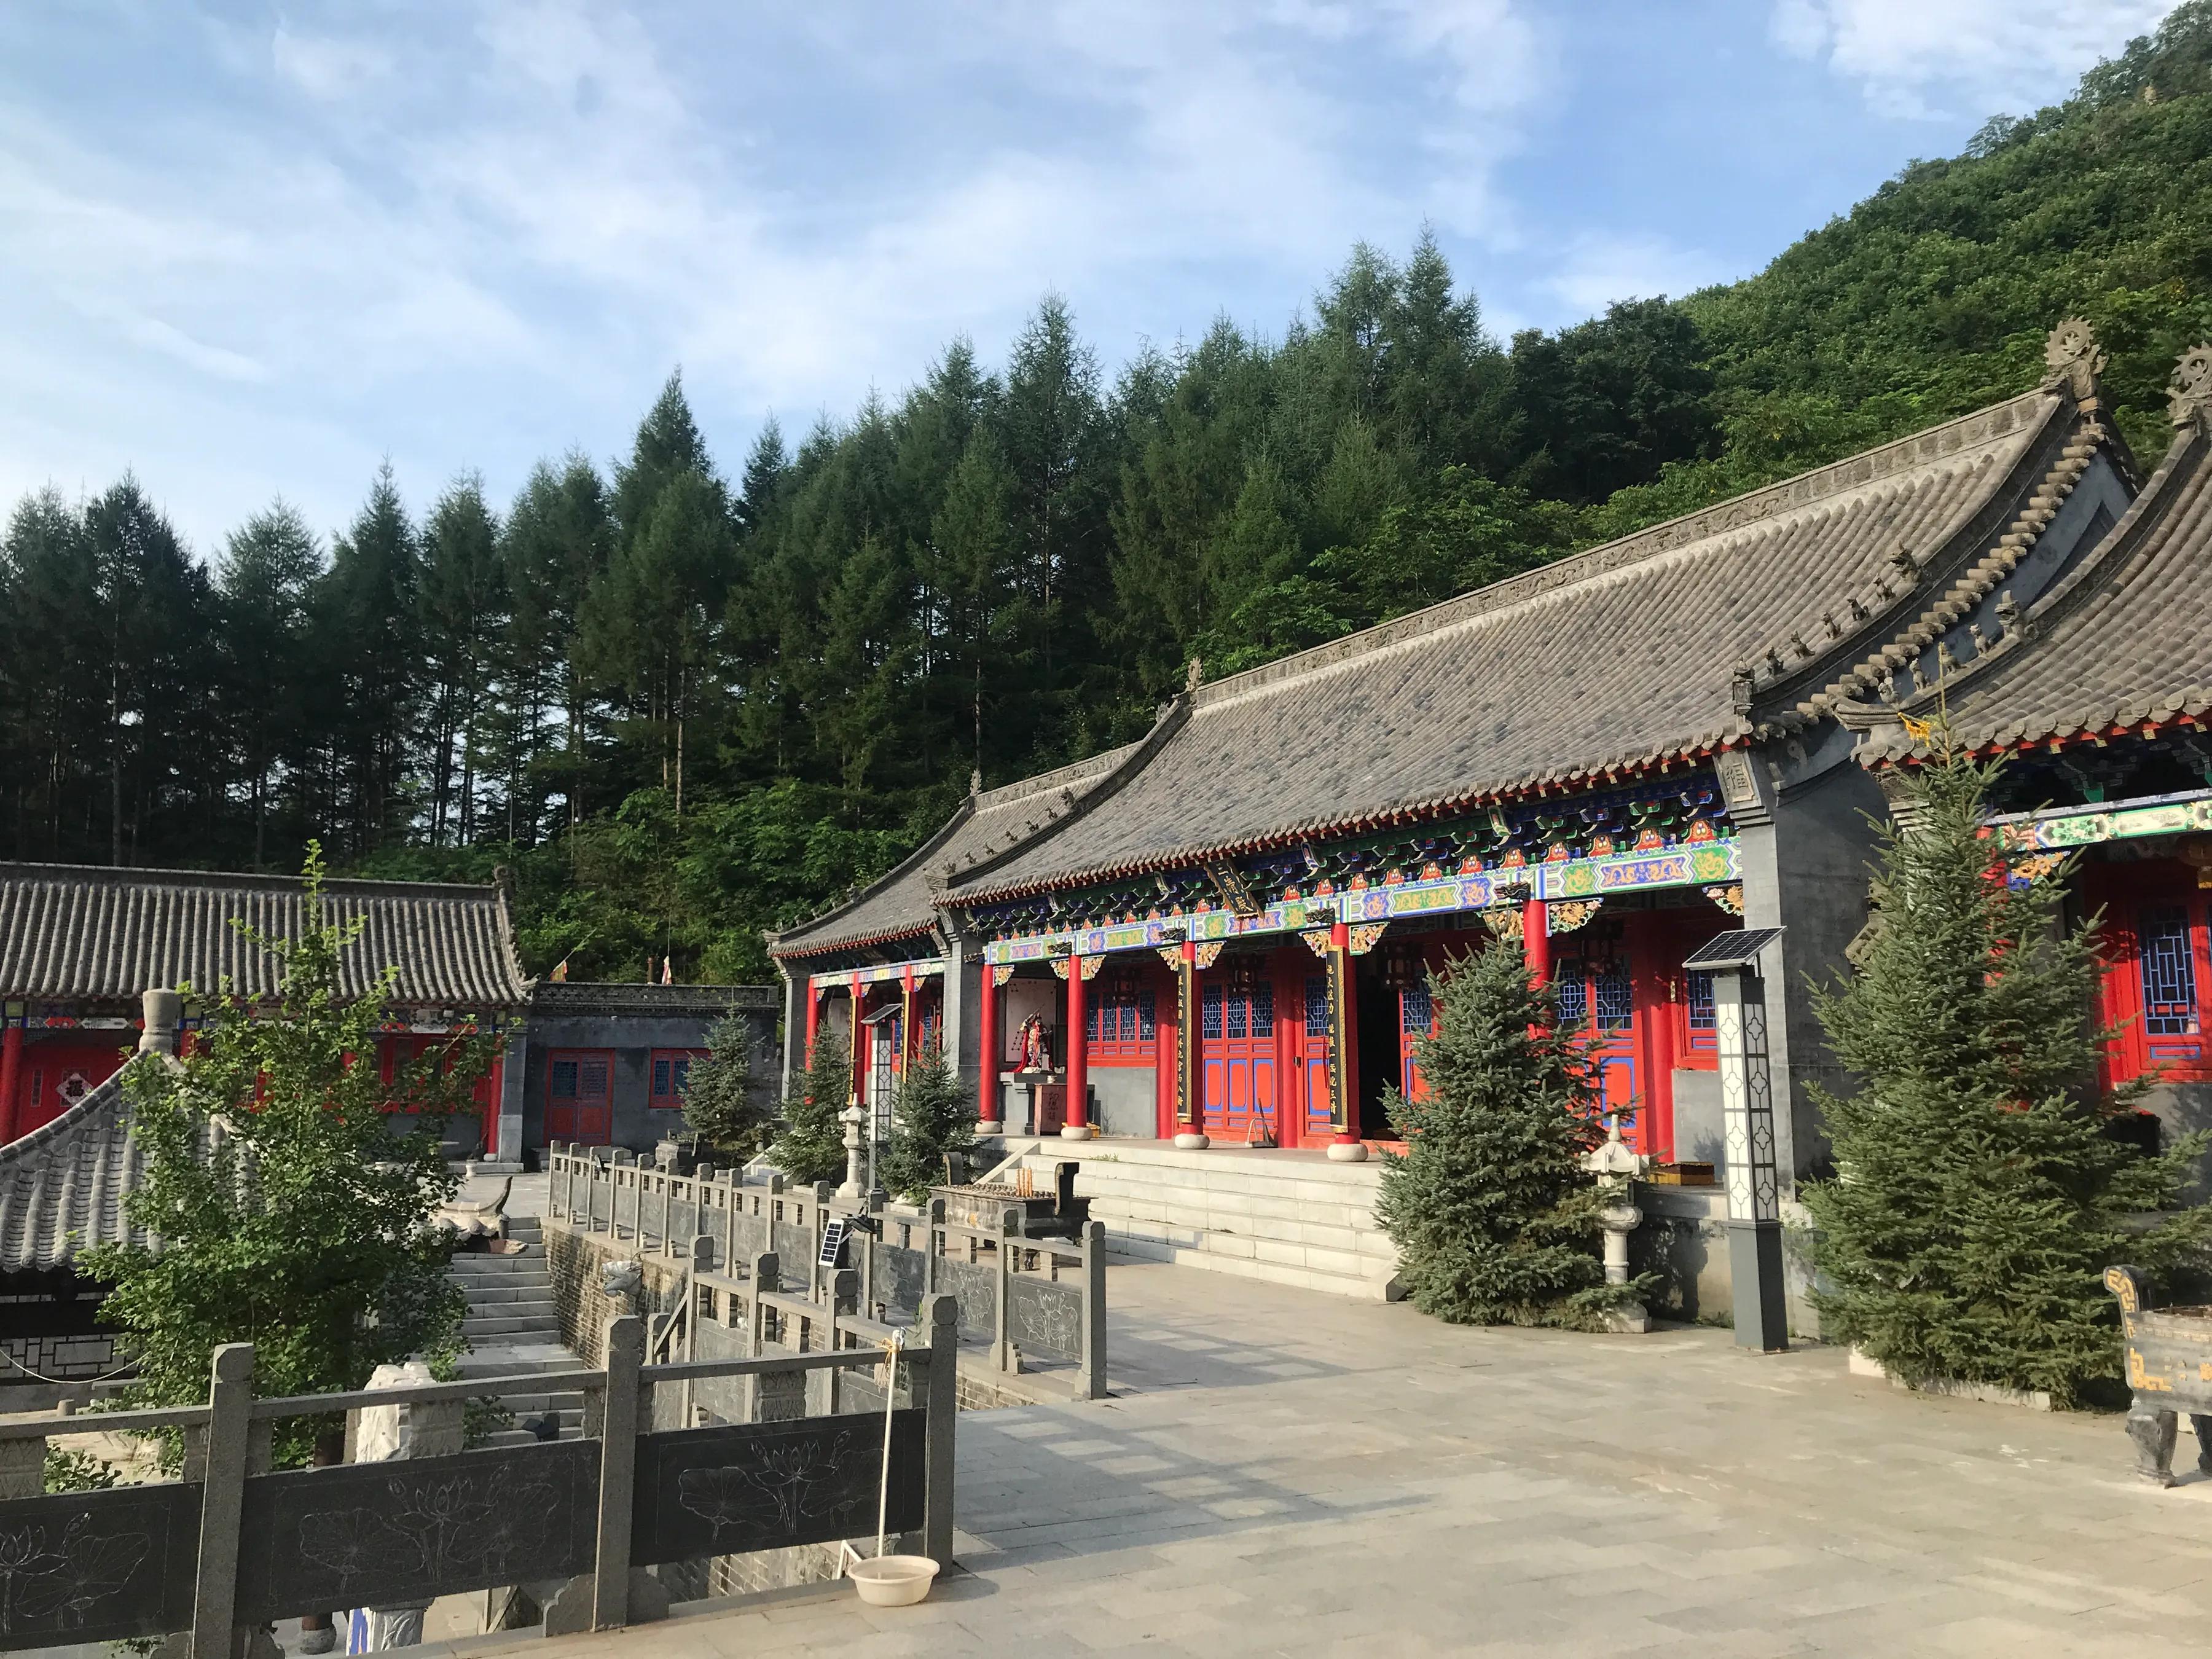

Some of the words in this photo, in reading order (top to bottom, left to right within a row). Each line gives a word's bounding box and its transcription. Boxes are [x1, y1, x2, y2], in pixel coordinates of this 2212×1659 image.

[1726, 763, 1748, 790] 福
[1215, 862, 1254, 912] 三清殿
[66, 1080, 84, 1097] 福
